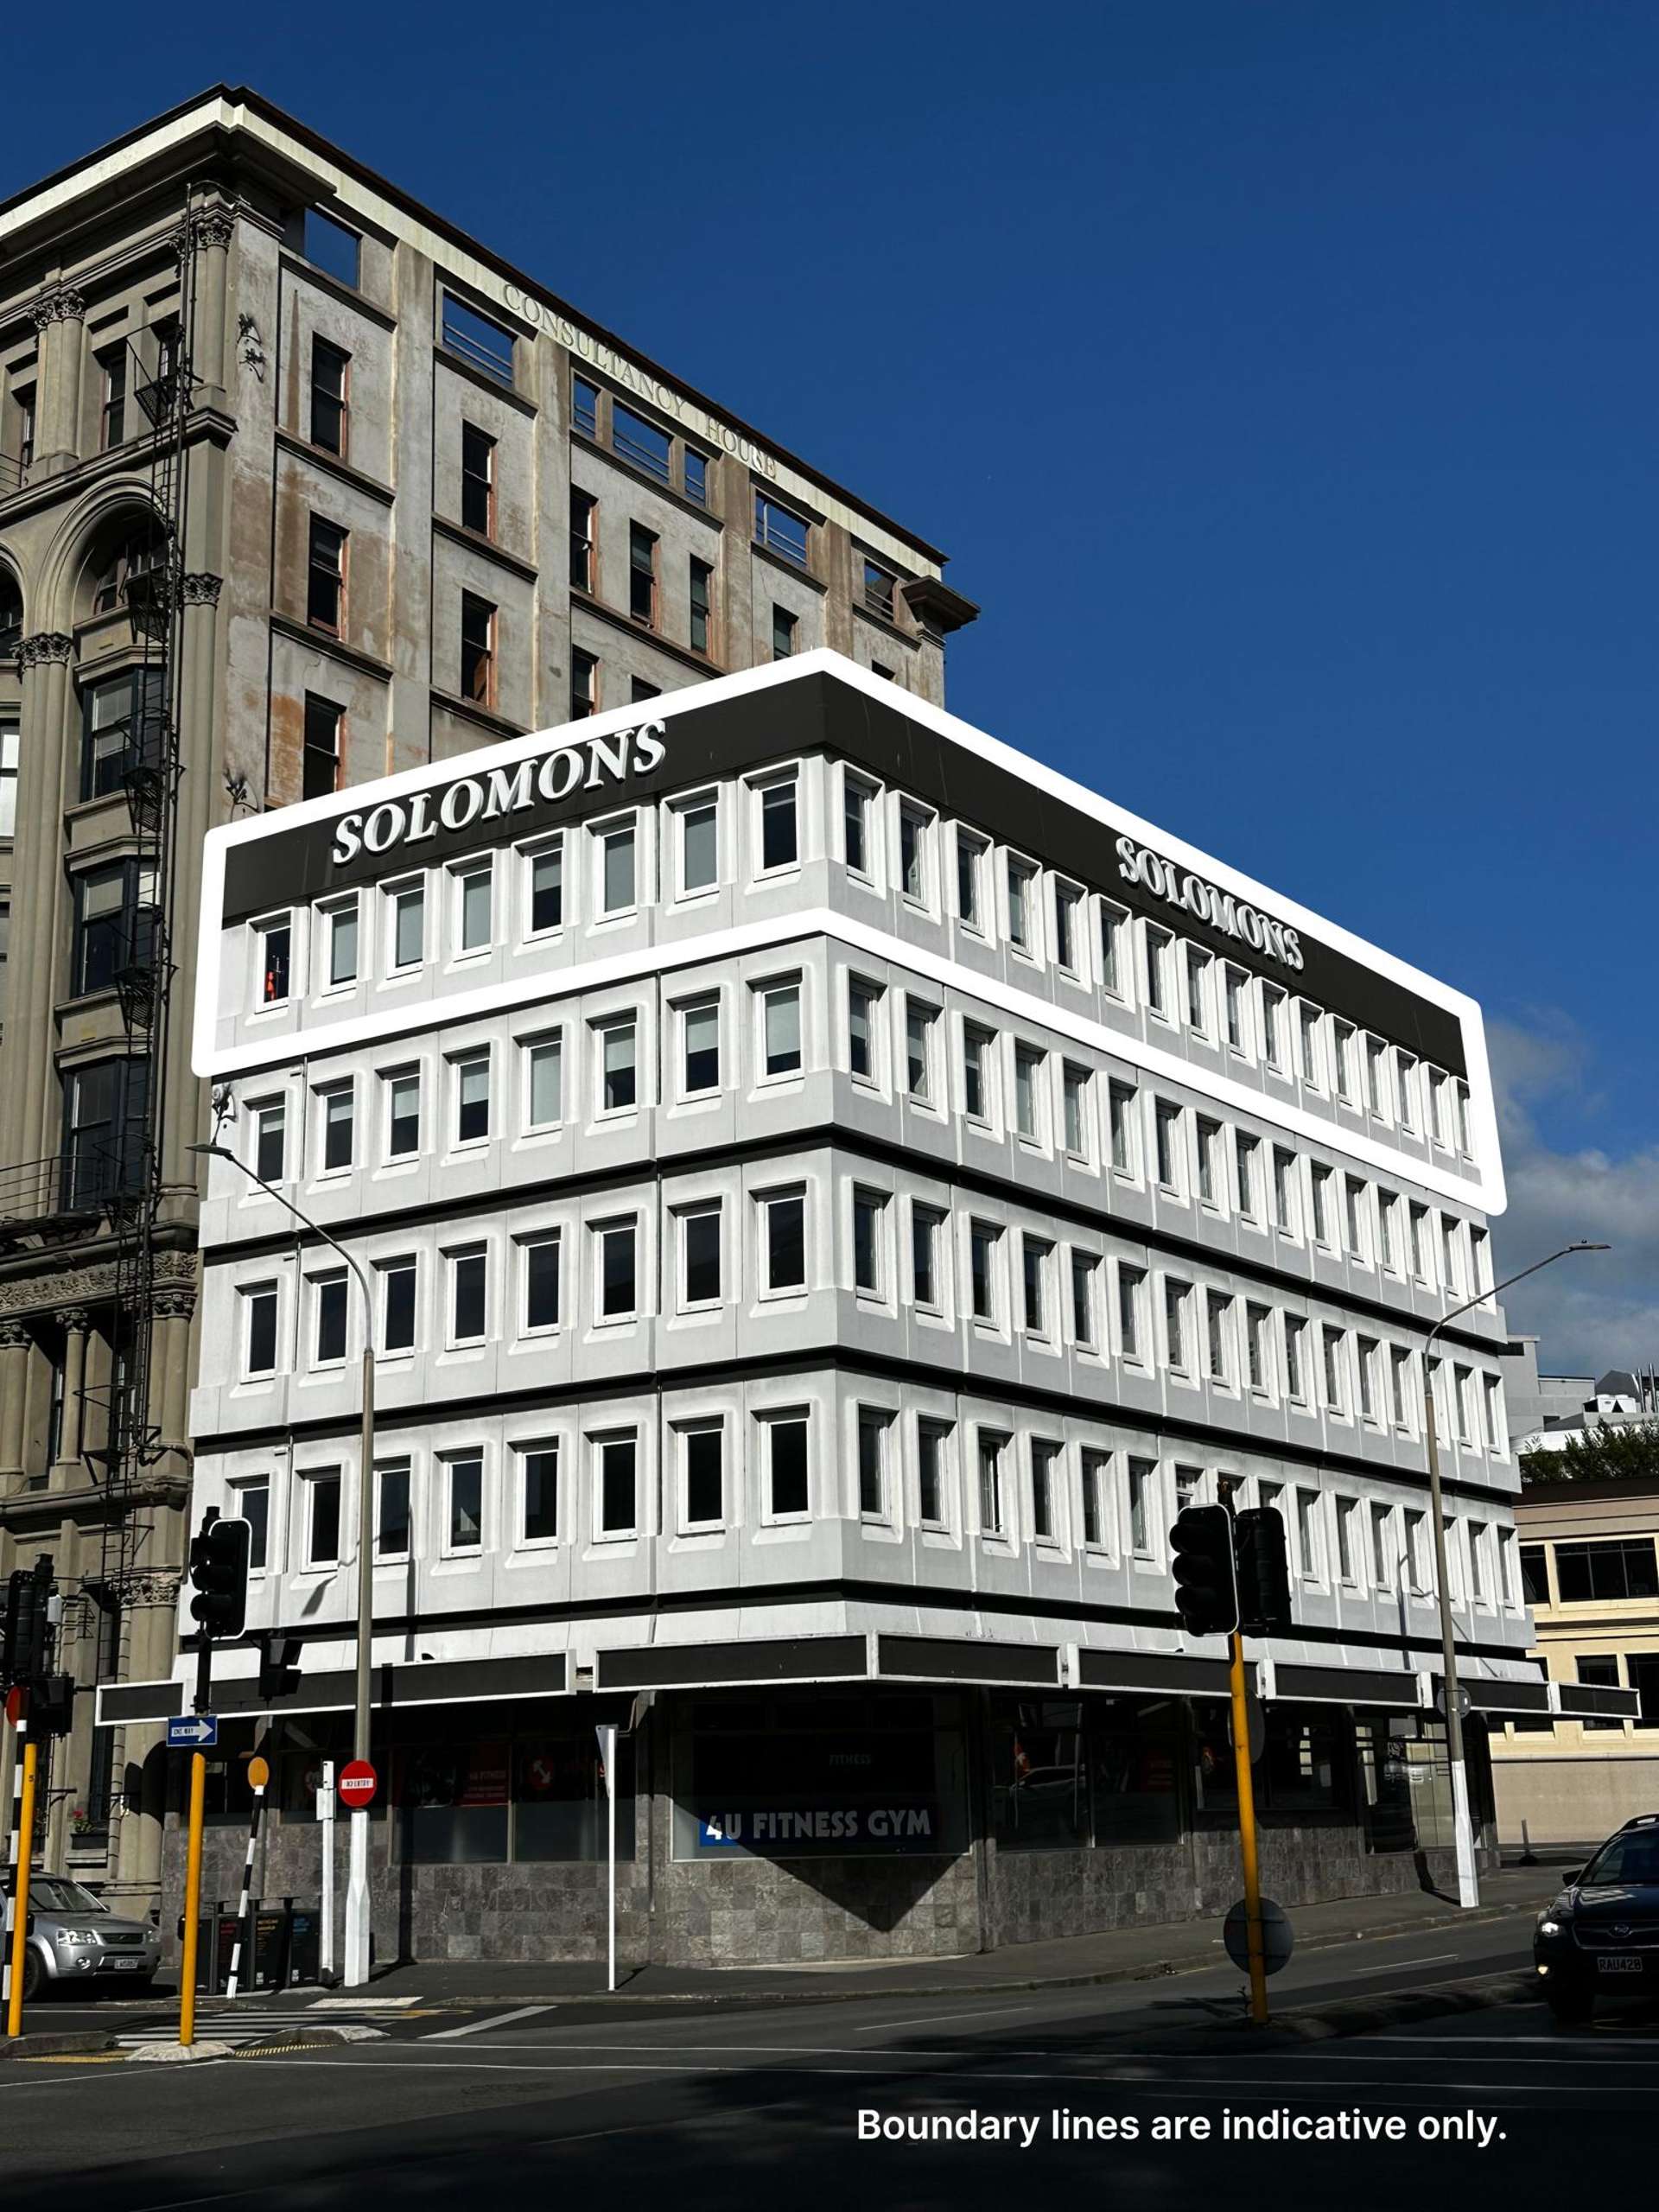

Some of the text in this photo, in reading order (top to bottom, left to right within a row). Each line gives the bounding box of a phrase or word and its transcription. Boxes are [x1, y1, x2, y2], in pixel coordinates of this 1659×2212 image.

[503, 283, 777, 479] CONSULTANCY HOUSE
[333, 719, 667, 865] SOLOMONS
[1116, 836, 1305, 970] SOLOMONS
[705, 1809, 931, 1840] 4U FITNESS GYM
